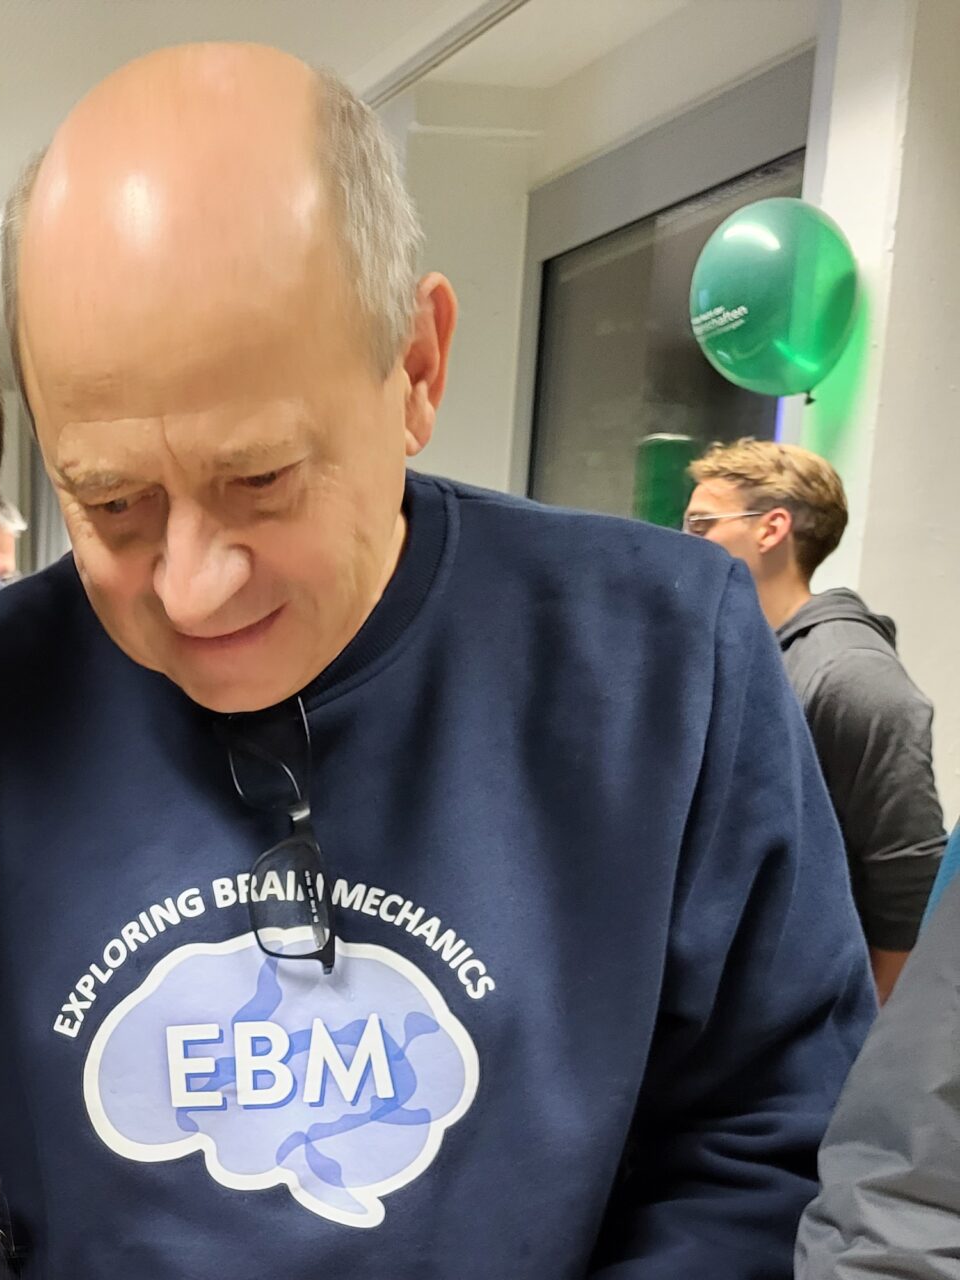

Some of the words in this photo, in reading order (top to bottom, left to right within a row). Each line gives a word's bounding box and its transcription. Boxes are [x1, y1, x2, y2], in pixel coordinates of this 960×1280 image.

[53, 887, 206, 1039] EXPLORING
[332, 878, 495, 1000] MECHANICS
[166, 1013, 396, 1109] EBM
